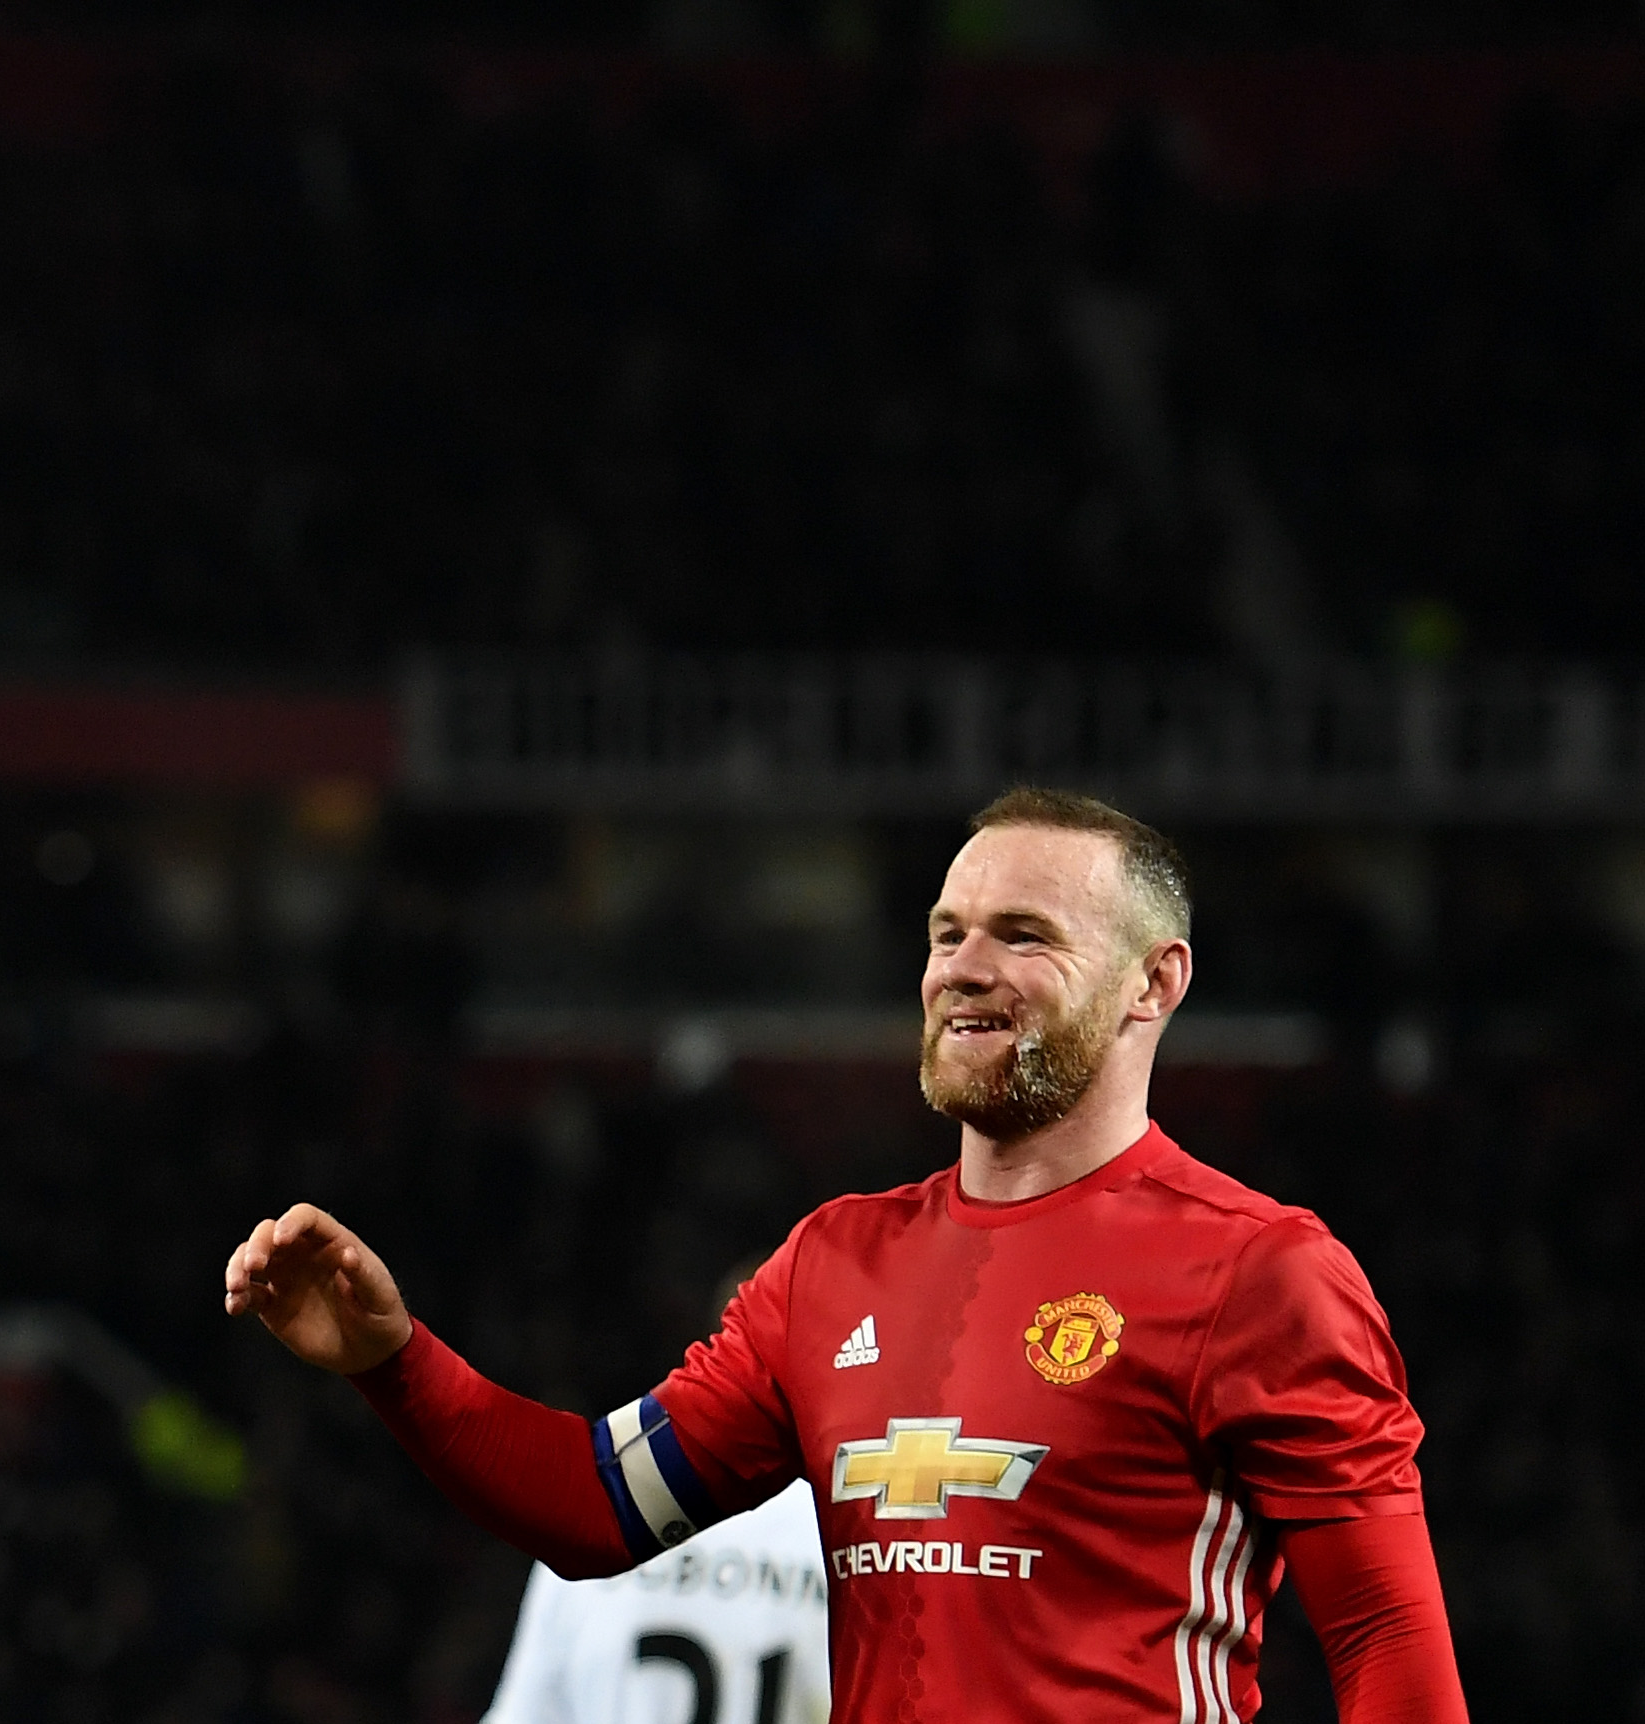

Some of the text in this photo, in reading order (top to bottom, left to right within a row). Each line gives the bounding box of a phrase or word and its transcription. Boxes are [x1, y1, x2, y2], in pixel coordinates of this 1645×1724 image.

[833, 1347, 880, 1369] adidas
[1037, 1358, 1090, 1378] UNITED
[832, 1541, 1043, 1579] CHEVROLET
